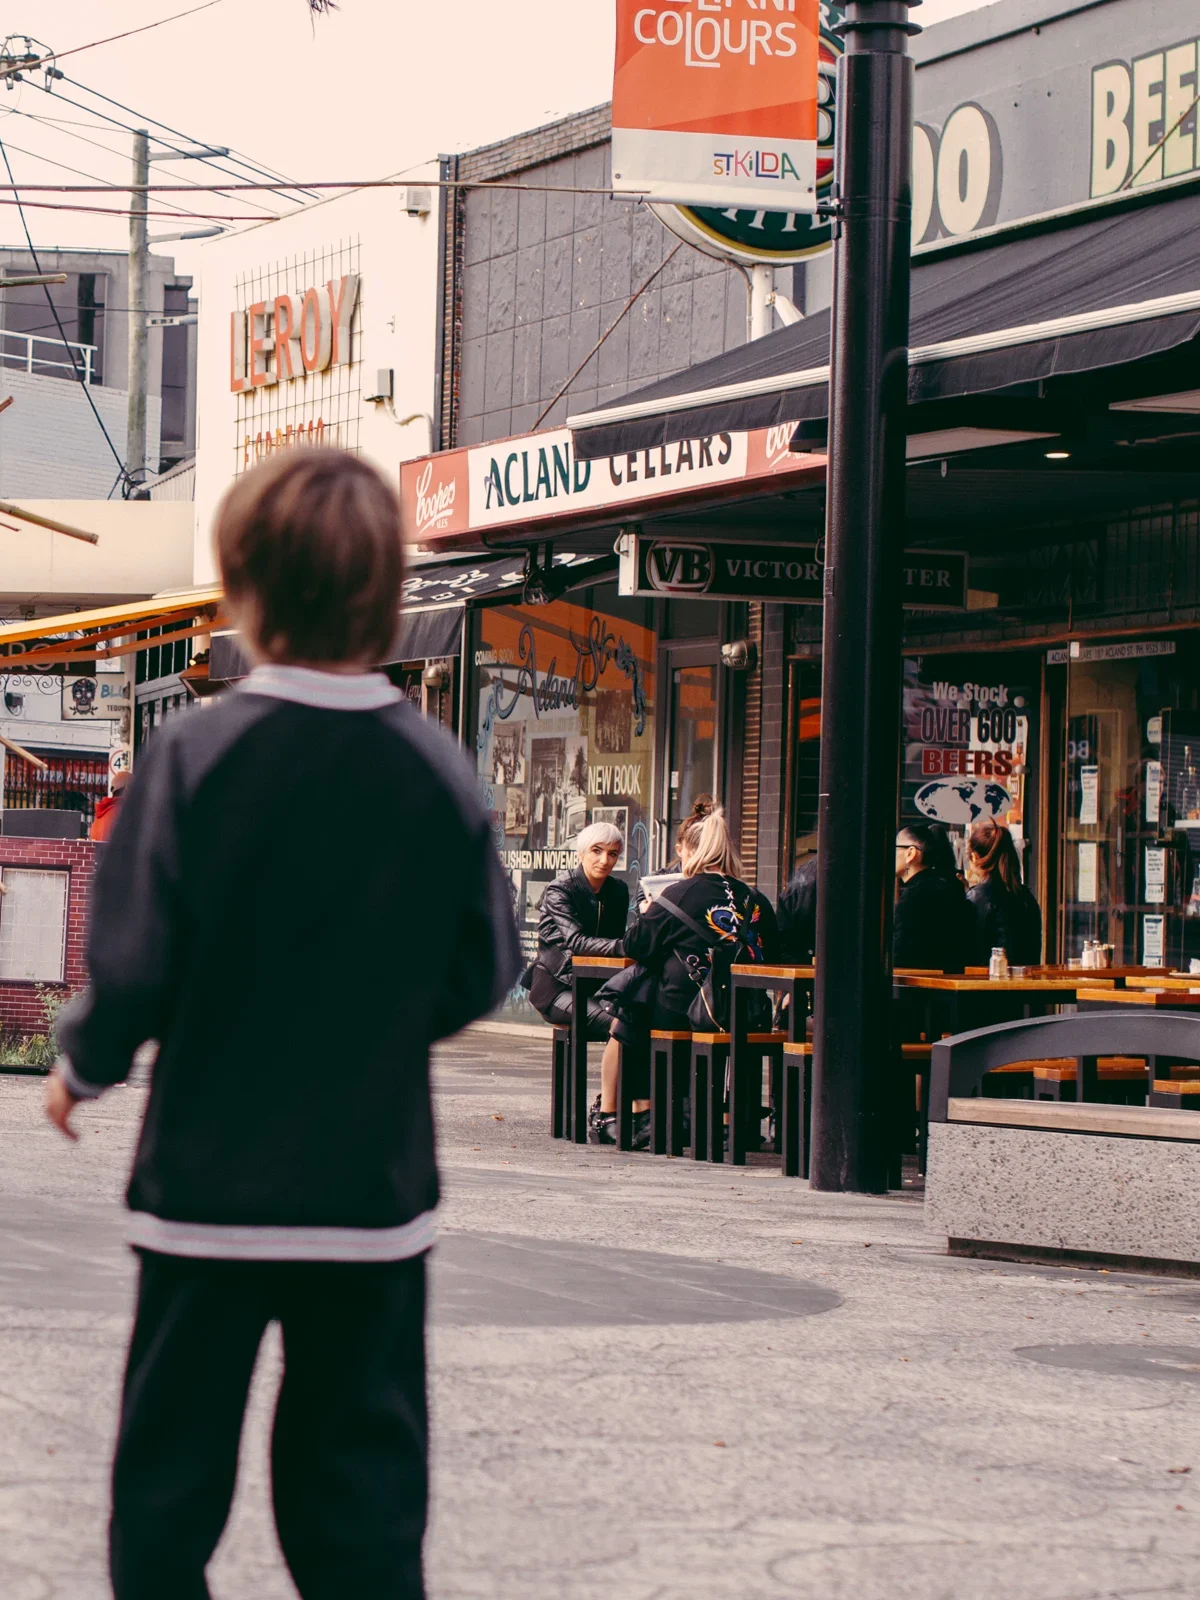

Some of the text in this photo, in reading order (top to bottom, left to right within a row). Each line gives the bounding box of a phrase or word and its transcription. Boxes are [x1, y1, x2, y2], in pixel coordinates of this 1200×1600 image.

[634, 8, 797, 68] COLOURS
[1089, 36, 1200, 200] BEE
[231, 274, 358, 392] LEROY
[484, 442, 592, 510] ACLAND
[651, 546, 711, 584] VB
[726, 558, 951, 587] VICTOR TER
[932, 681, 1009, 702] We Stock
[920, 708, 1017, 744] OVER 600
[588, 763, 641, 796] NEW BOOK
[921, 748, 1013, 776] BEERS
[533, 850, 543, 870] IN
[544, 850, 579, 870] NOVEMB
